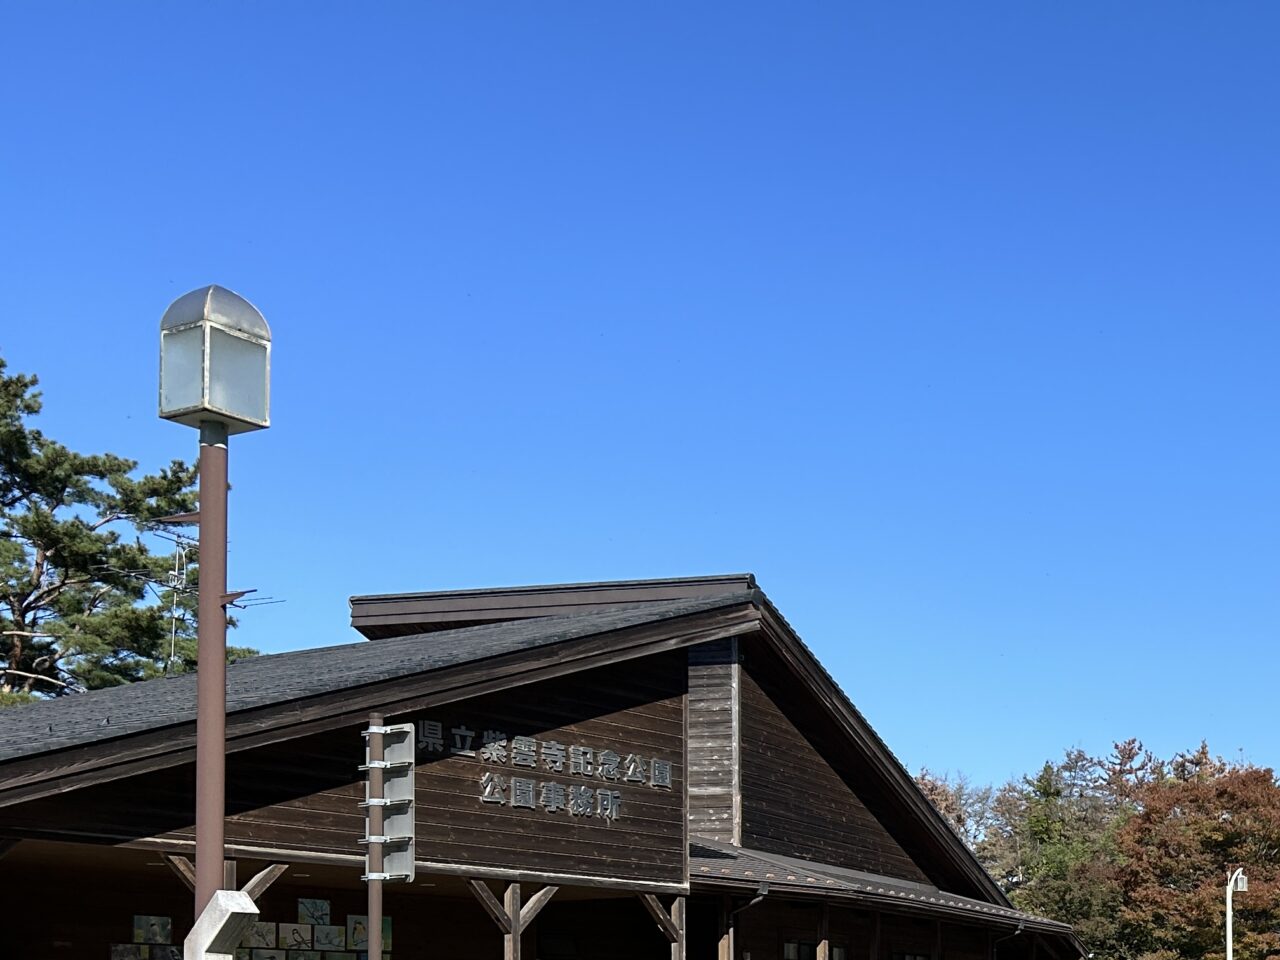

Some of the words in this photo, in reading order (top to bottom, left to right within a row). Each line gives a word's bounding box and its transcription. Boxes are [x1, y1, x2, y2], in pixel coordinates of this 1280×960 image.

[418, 720, 673, 790] 県立紫雲寺記念公園
[480, 771, 622, 821] 公園事務所
